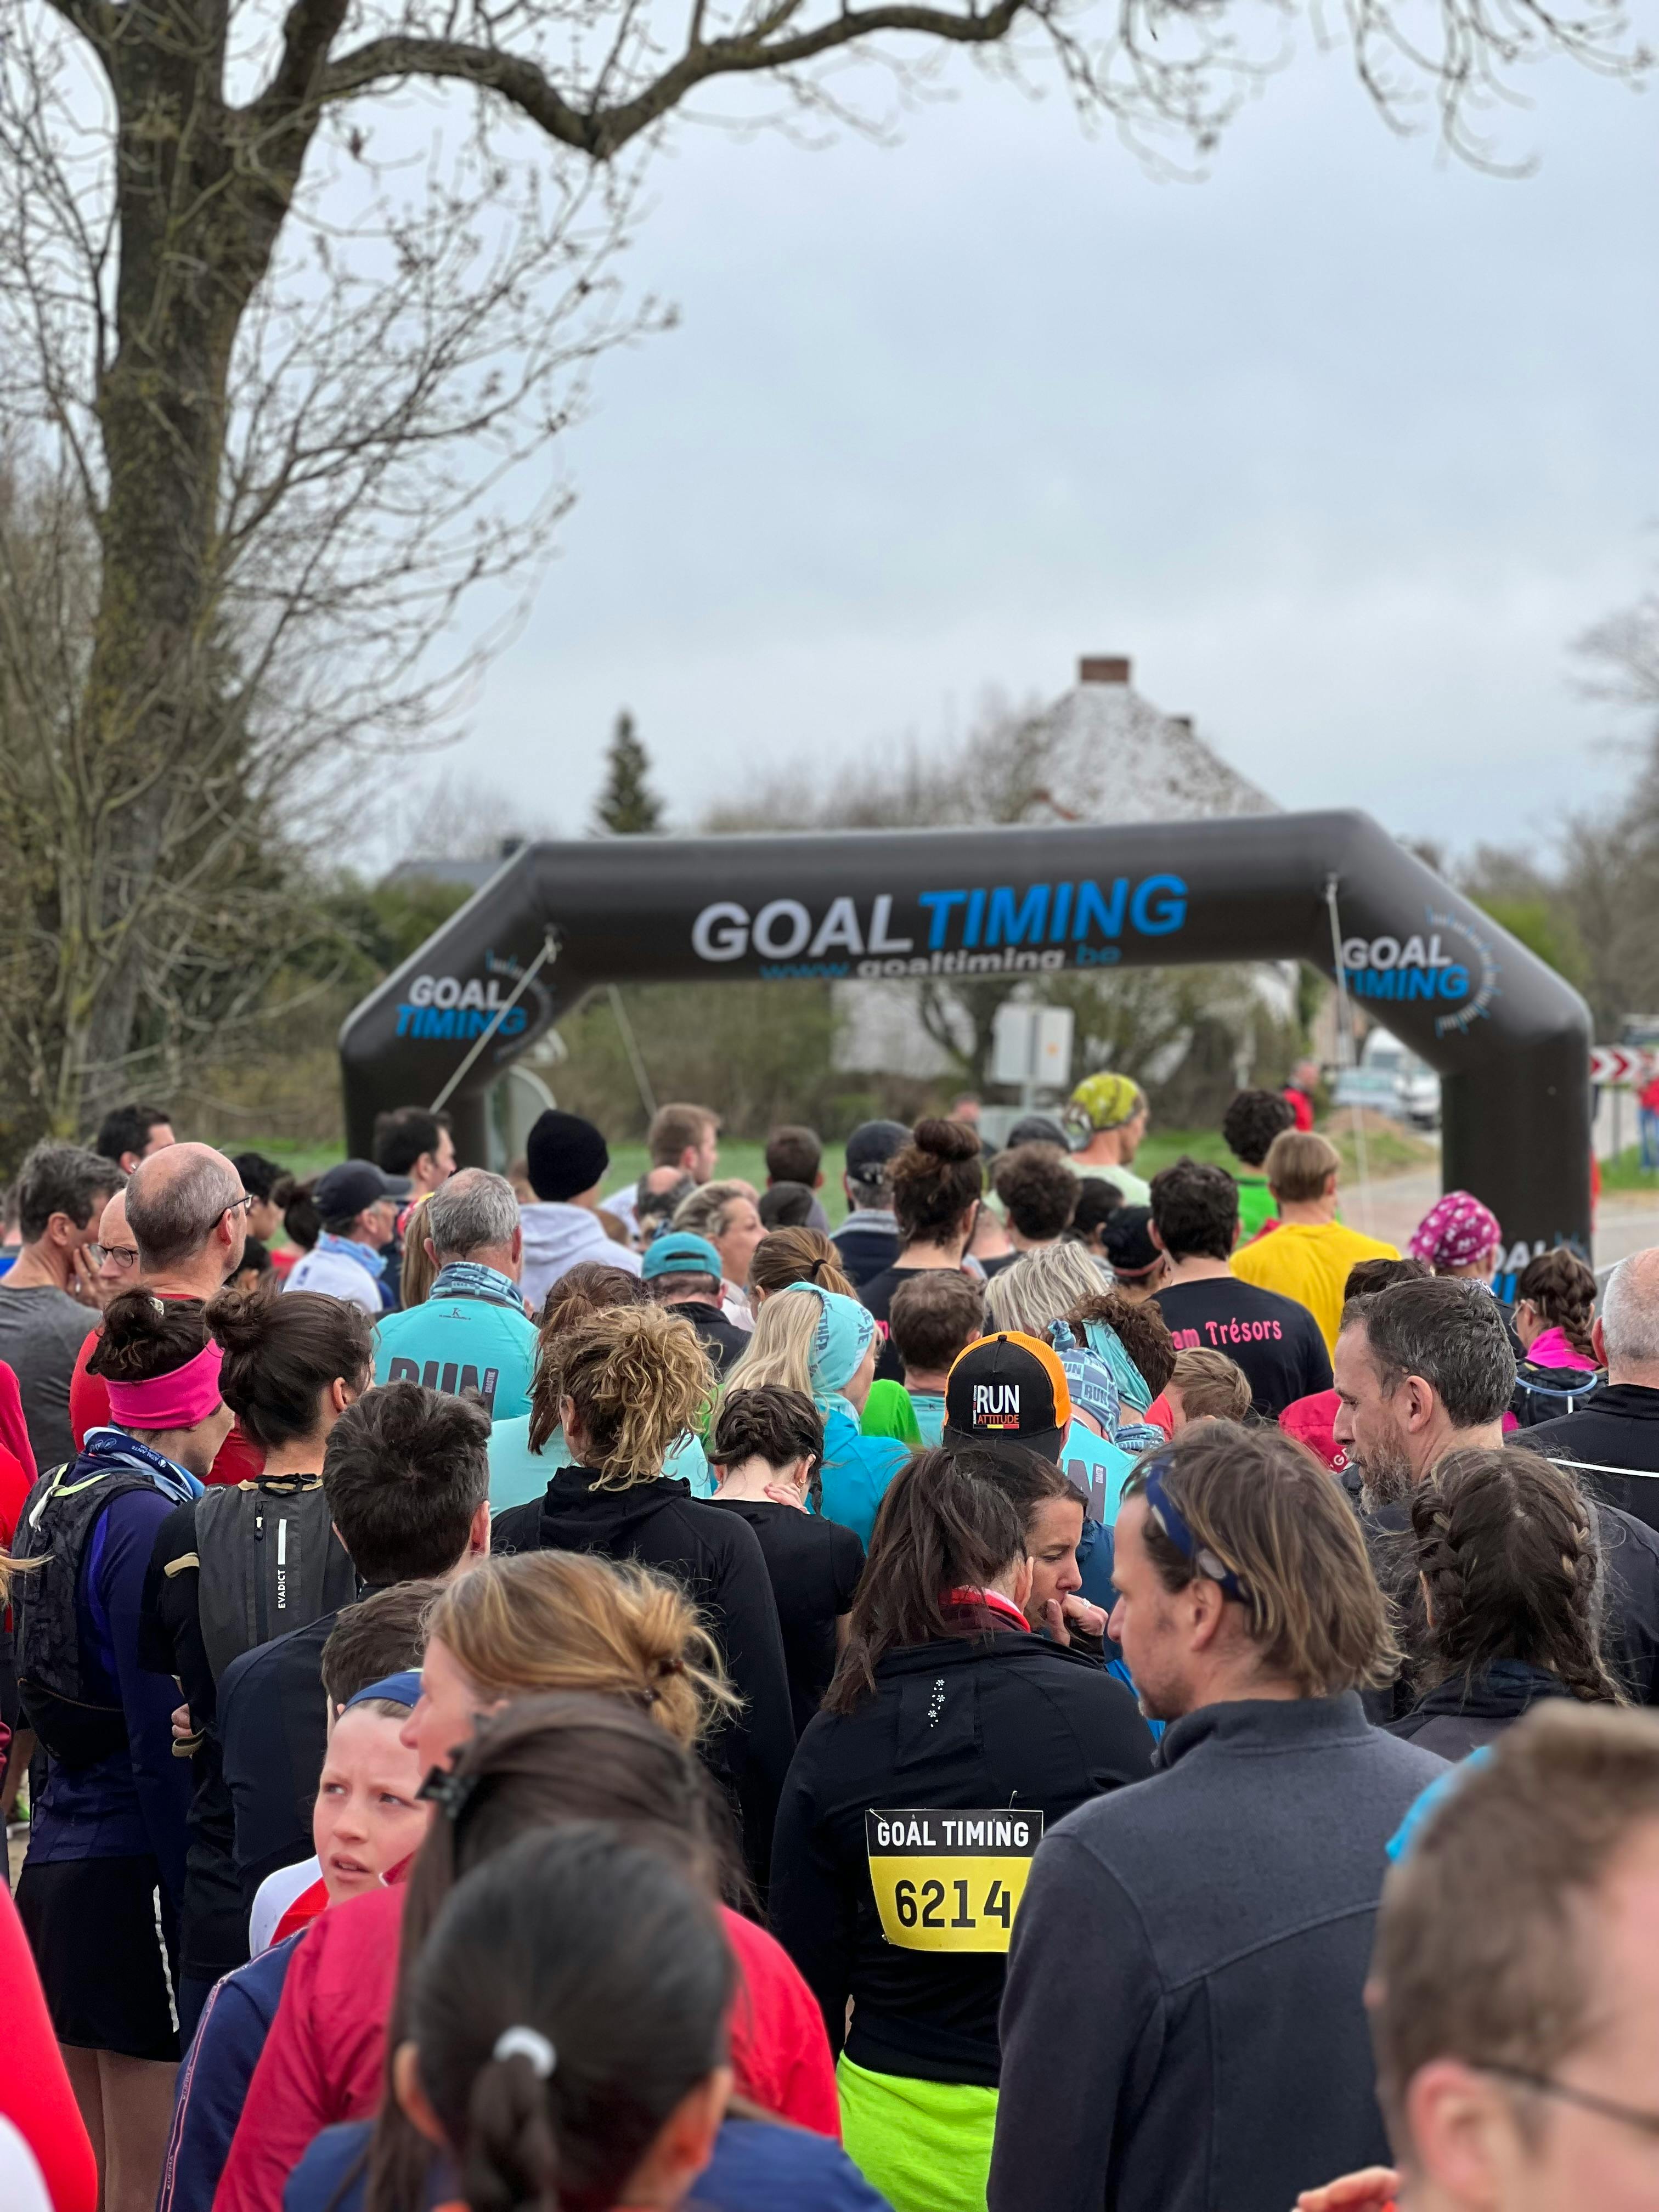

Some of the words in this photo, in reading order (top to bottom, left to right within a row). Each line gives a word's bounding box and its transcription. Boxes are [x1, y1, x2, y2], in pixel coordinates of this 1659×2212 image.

[692, 894, 914, 961] GOAL
[918, 873, 1188, 950] TIMING
[1343, 934, 1453, 969] GOAL
[409, 974, 509, 1009] GOAL
[396, 1003, 527, 1039] TIMING
[1170, 1328, 1200, 1349] am
[1205, 1318, 1282, 1345] Trésors
[1064, 1363, 1081, 1375] UN
[977, 1385, 1019, 1413] RUN
[978, 1414, 1020, 1424] ATTITUDE
[278, 1570, 286, 1609] EVADICT
[878, 1821, 936, 1847] GOAL
[942, 1821, 1029, 1847] TIMING
[895, 1879, 1011, 1928] 6214
